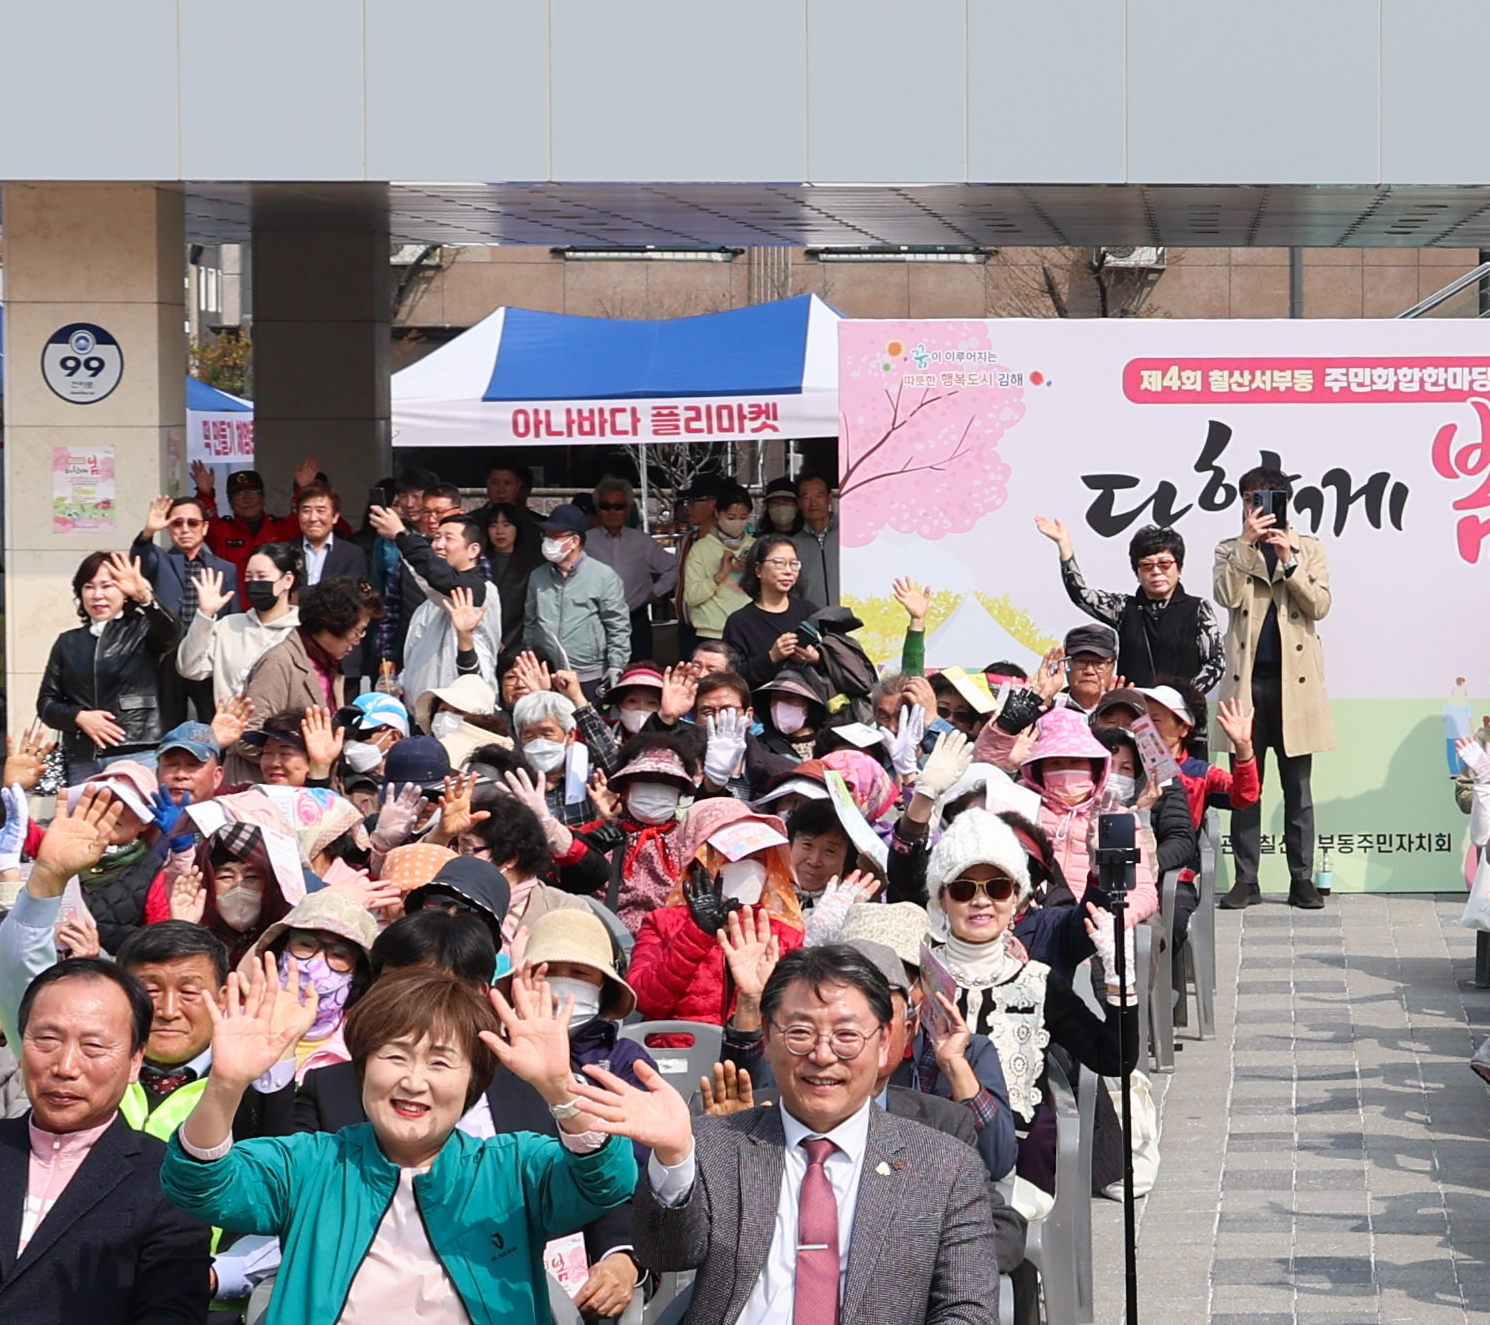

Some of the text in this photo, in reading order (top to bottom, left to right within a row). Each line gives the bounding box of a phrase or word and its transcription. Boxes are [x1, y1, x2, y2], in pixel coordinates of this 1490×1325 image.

[59, 356, 106, 378] 99
[944, 351, 997, 363] 이루어지는
[904, 372, 1023, 387] 따뜻한 행복도시 김해
[1140, 366, 1202, 392] 제4회
[1208, 368, 1314, 393] 칠산서부동
[511, 401, 780, 439] 아나바다 플리마켓
